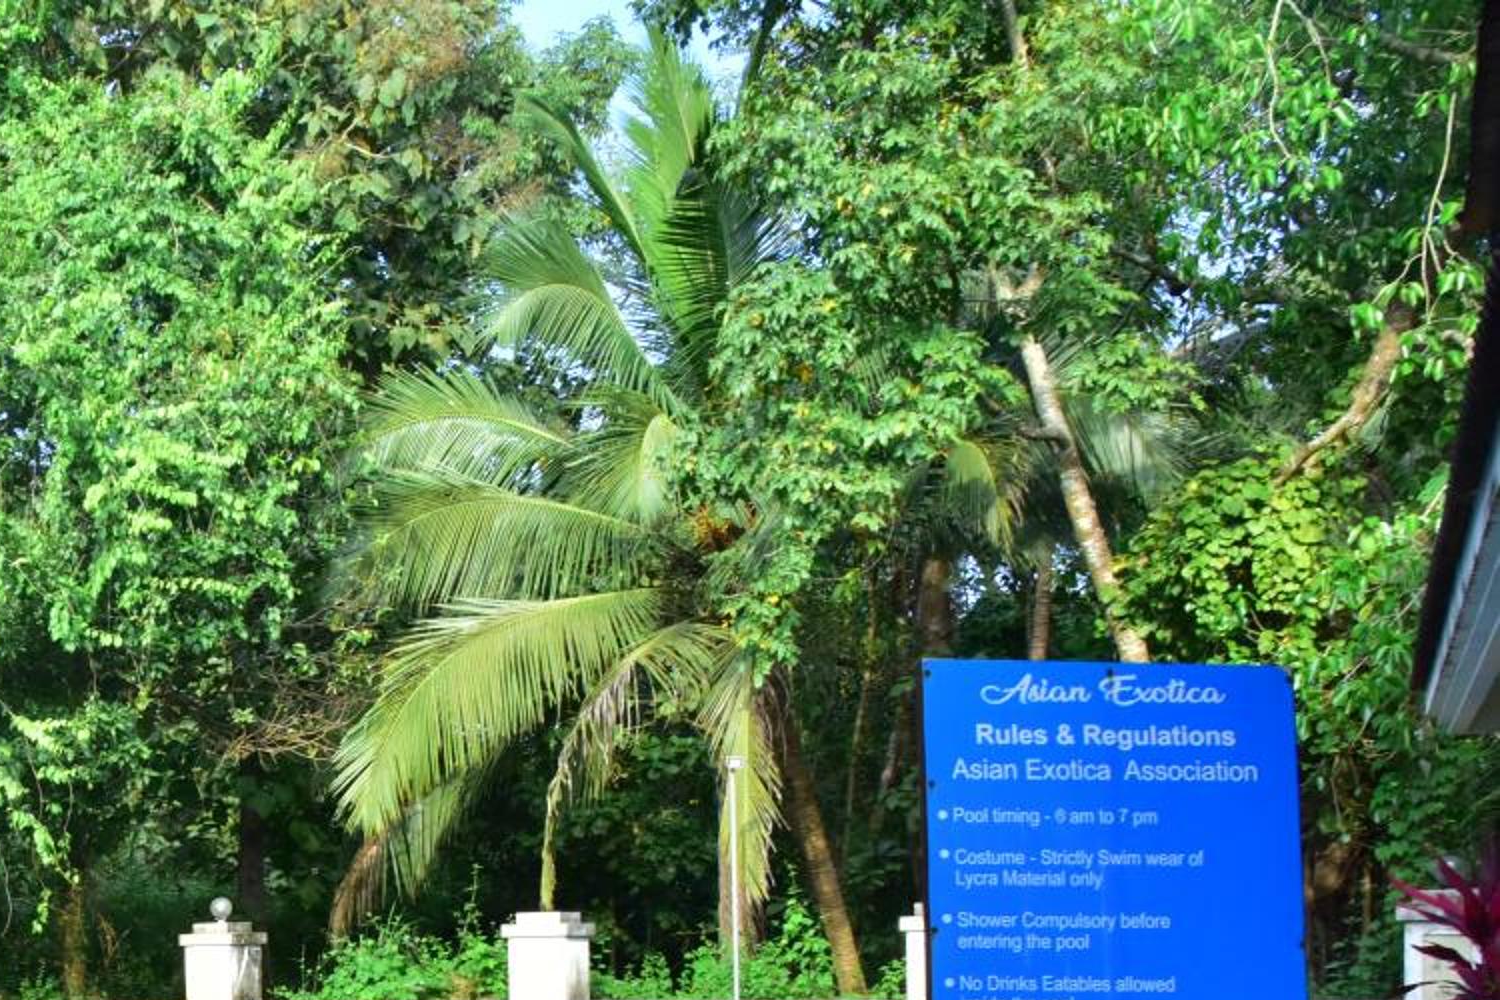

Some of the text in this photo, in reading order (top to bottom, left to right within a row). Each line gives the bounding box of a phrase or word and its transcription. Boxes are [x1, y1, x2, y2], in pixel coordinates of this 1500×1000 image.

[979, 672, 1226, 708] Asian Exotica
[975, 723, 1236, 751] Rules & Regulations
[952, 758, 1258, 783] Asian Exotica Association
[953, 808, 988, 823] Pool
[992, 808, 1041, 827] timing
[1070, 811, 1095, 824] am
[1099, 809, 1114, 825] to
[1118, 809, 1127, 824] 7
[1132, 811, 1158, 828] pm
[954, 849, 1025, 865] Costume
[1040, 849, 1093, 868] Strictly
[1098, 850, 1141, 865] Swim
[1145, 853, 1183, 865] wear
[1188, 850, 1204, 866] of
[955, 870, 1104, 890] Lycra Material only
[957, 912, 1171, 932] Shower Compulsory before
[957, 934, 1090, 953] entering the pool
[959, 976, 1176, 992] No Drinks Eatables allowed
